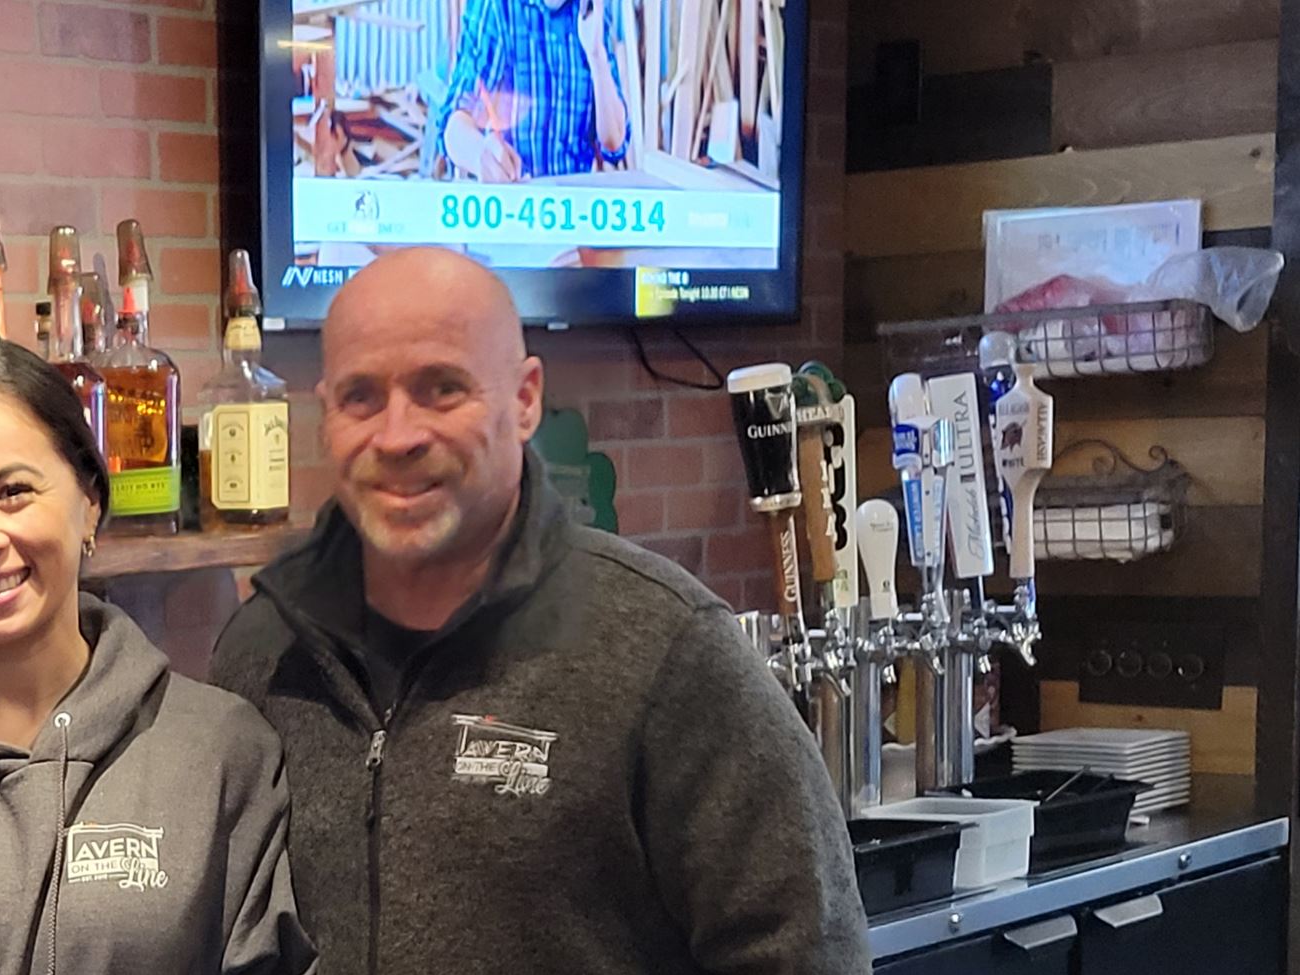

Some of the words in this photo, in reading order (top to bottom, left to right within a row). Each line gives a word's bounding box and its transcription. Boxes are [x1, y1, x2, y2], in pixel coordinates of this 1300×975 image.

[441, 194, 666, 233] 800-461-0314
[747, 422, 793, 439] GUINN
[954, 390, 975, 471] ULTRA
[780, 530, 798, 603] GUINNESS
[494, 760, 552, 798] Line
[71, 864, 90, 875] ON
[95, 861, 118, 872] THE
[118, 857, 169, 893] Line
